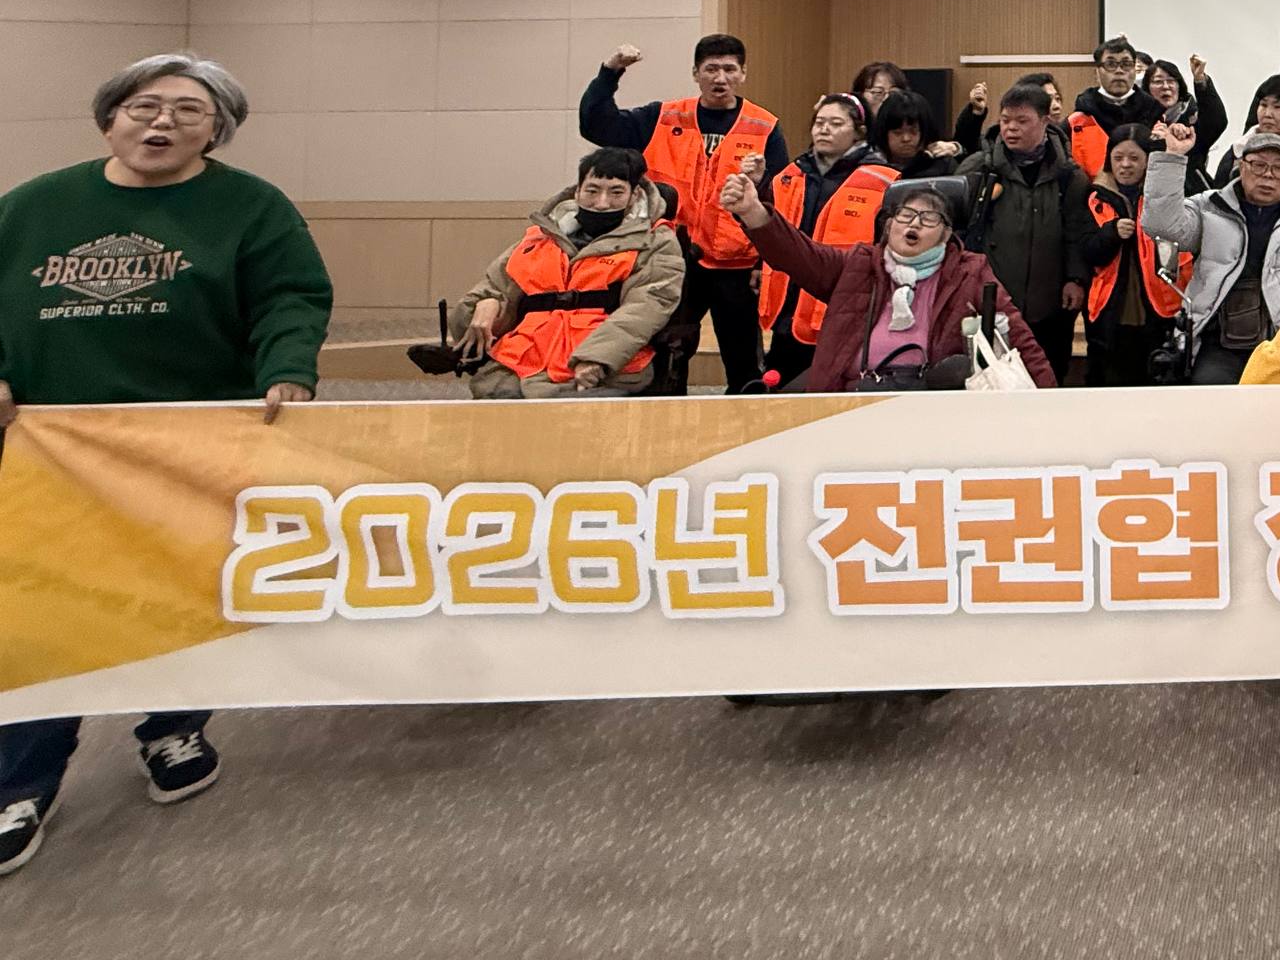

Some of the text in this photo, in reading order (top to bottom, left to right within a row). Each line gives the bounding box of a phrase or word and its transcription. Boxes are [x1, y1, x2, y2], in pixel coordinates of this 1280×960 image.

[40, 250, 183, 288] BROOKLYN
[39, 303, 104, 320] SUPERIOR
[108, 301, 145, 316] CLTH.
[150, 301, 169, 314] CO.
[223, 473, 785, 623] 2026년
[808, 458, 1230, 617] 전권협
